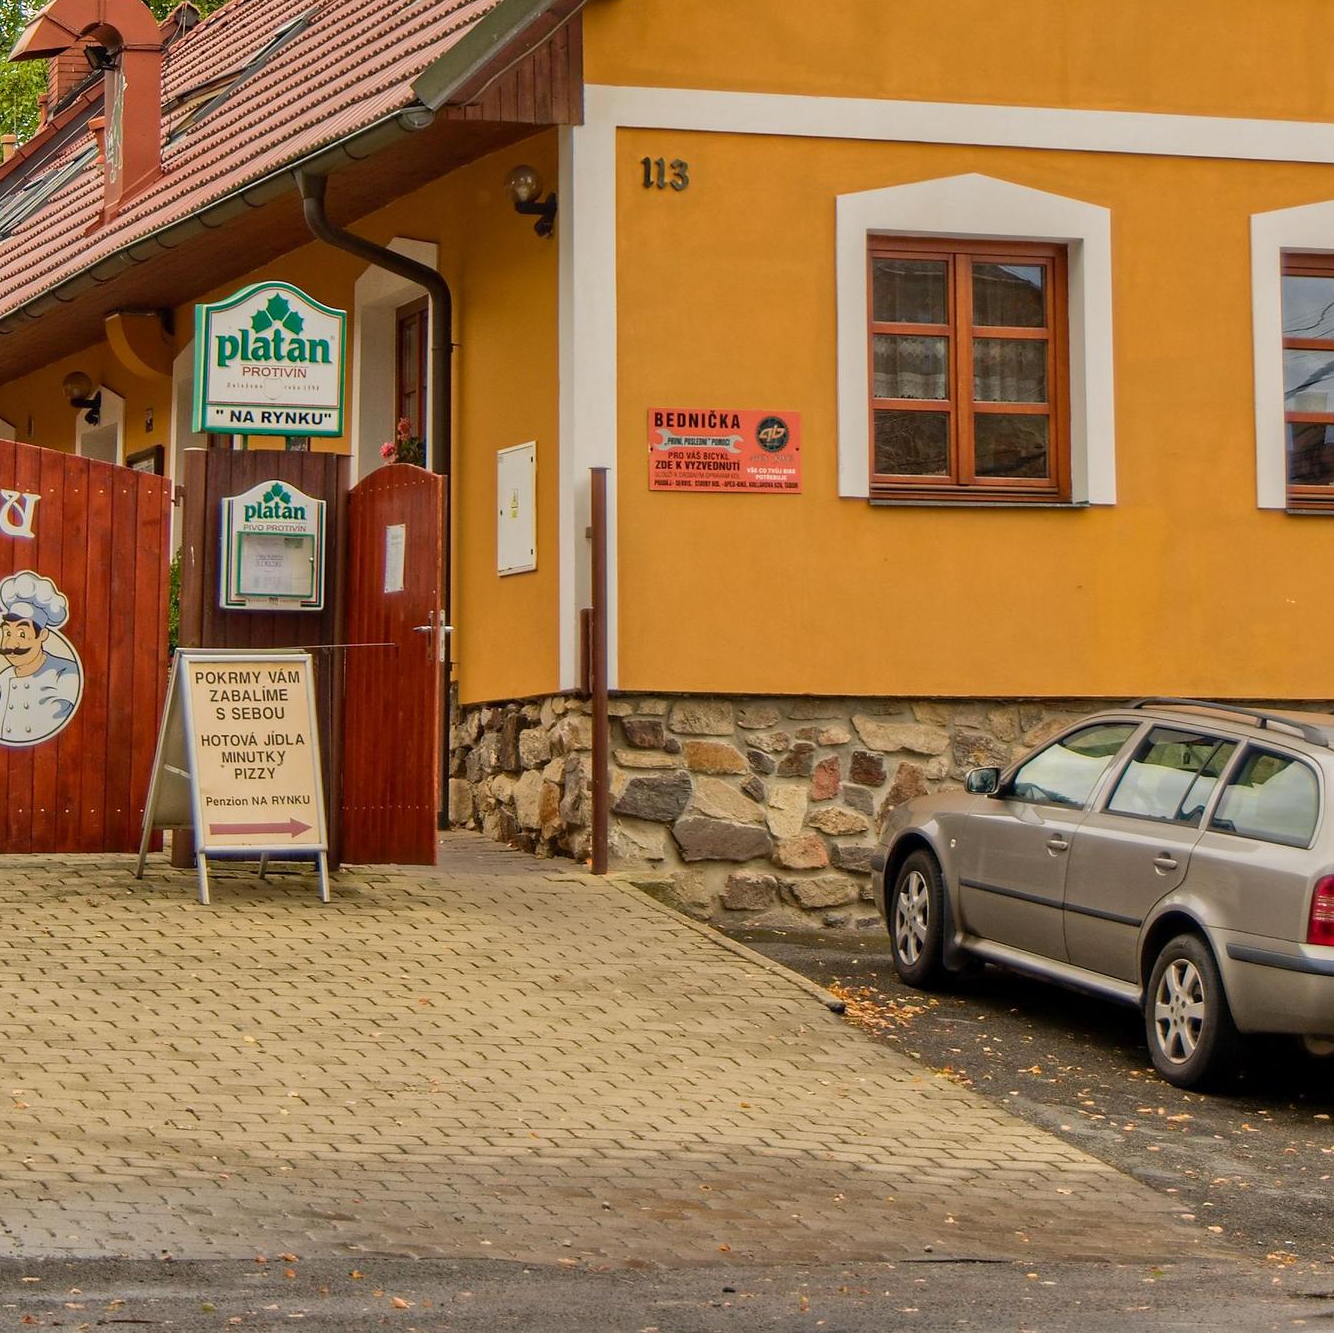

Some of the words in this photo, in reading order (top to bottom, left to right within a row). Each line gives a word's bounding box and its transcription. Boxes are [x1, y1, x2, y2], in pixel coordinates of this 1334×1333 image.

[641, 156, 689, 192] 113
[215, 327, 333, 367] platan
[261, 411, 332, 425] RYNKU"
[654, 410, 741, 429] BEDNIČKA
[668, 452, 684, 460] PRO
[686, 451, 701, 460] VÁŠ
[703, 452, 730, 461] BICYKL
[655, 460, 673, 470] ZDE
[676, 461, 683, 470] K
[685, 459, 741, 471] VYZVEDNUTÍ
[243, 501, 307, 522] platan
[195, 671, 261, 684] POKRMY
[268, 668, 300, 683] VÁM
[209, 686, 288, 702] ZABALÍME
[216, 708, 225, 720] S
[232, 707, 285, 720] SEBOU
[201, 732, 257, 746] HOTOVÁ
[263, 731, 305, 746] JÍDLA
[234, 768, 276, 780] PIZZY
[206, 796, 248, 806] Penzion
[252, 797, 268, 805] NA
[271, 795, 311, 805] RYNKU
